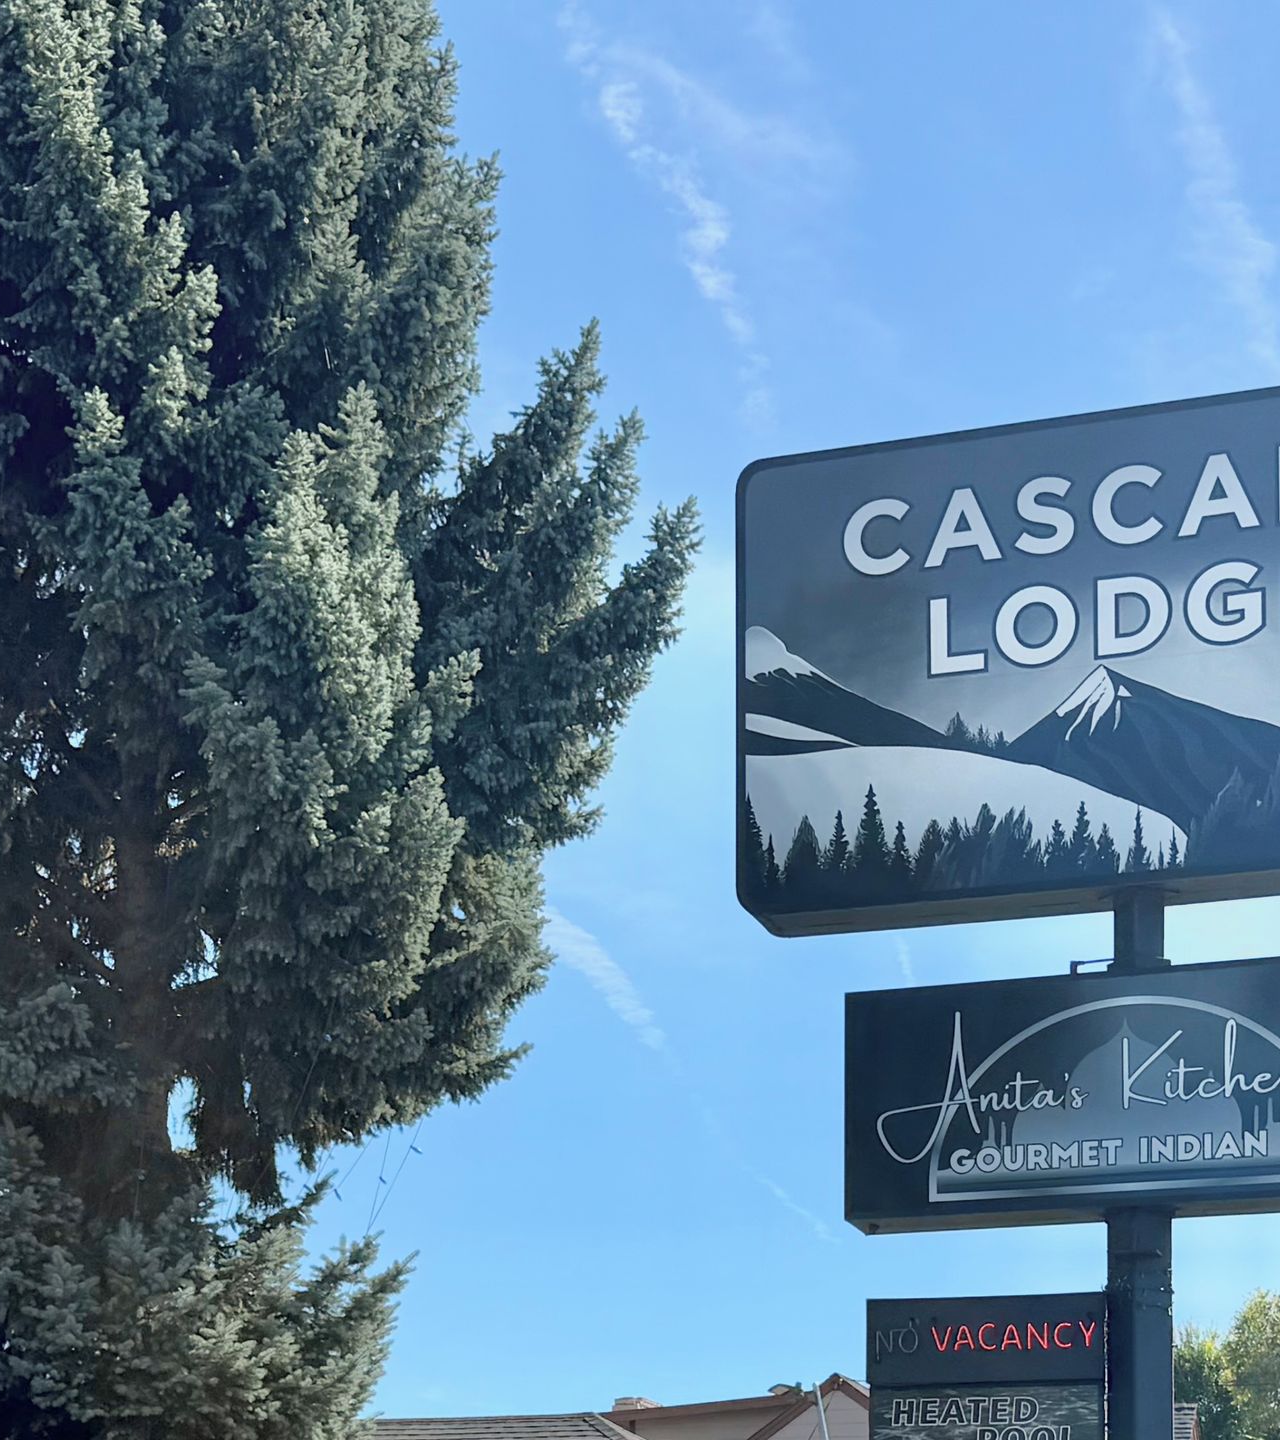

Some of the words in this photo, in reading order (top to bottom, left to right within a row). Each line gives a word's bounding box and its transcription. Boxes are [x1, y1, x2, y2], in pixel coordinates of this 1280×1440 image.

[876, 1010, 1089, 1164] Anita's
[950, 1138, 1123, 1175] GOURMET
[1139, 1129, 1268, 1165] INDIAN
[874, 1326, 918, 1362] NO
[930, 1320, 1097, 1354] VACANCY
[891, 1396, 1039, 1427] HEATED
